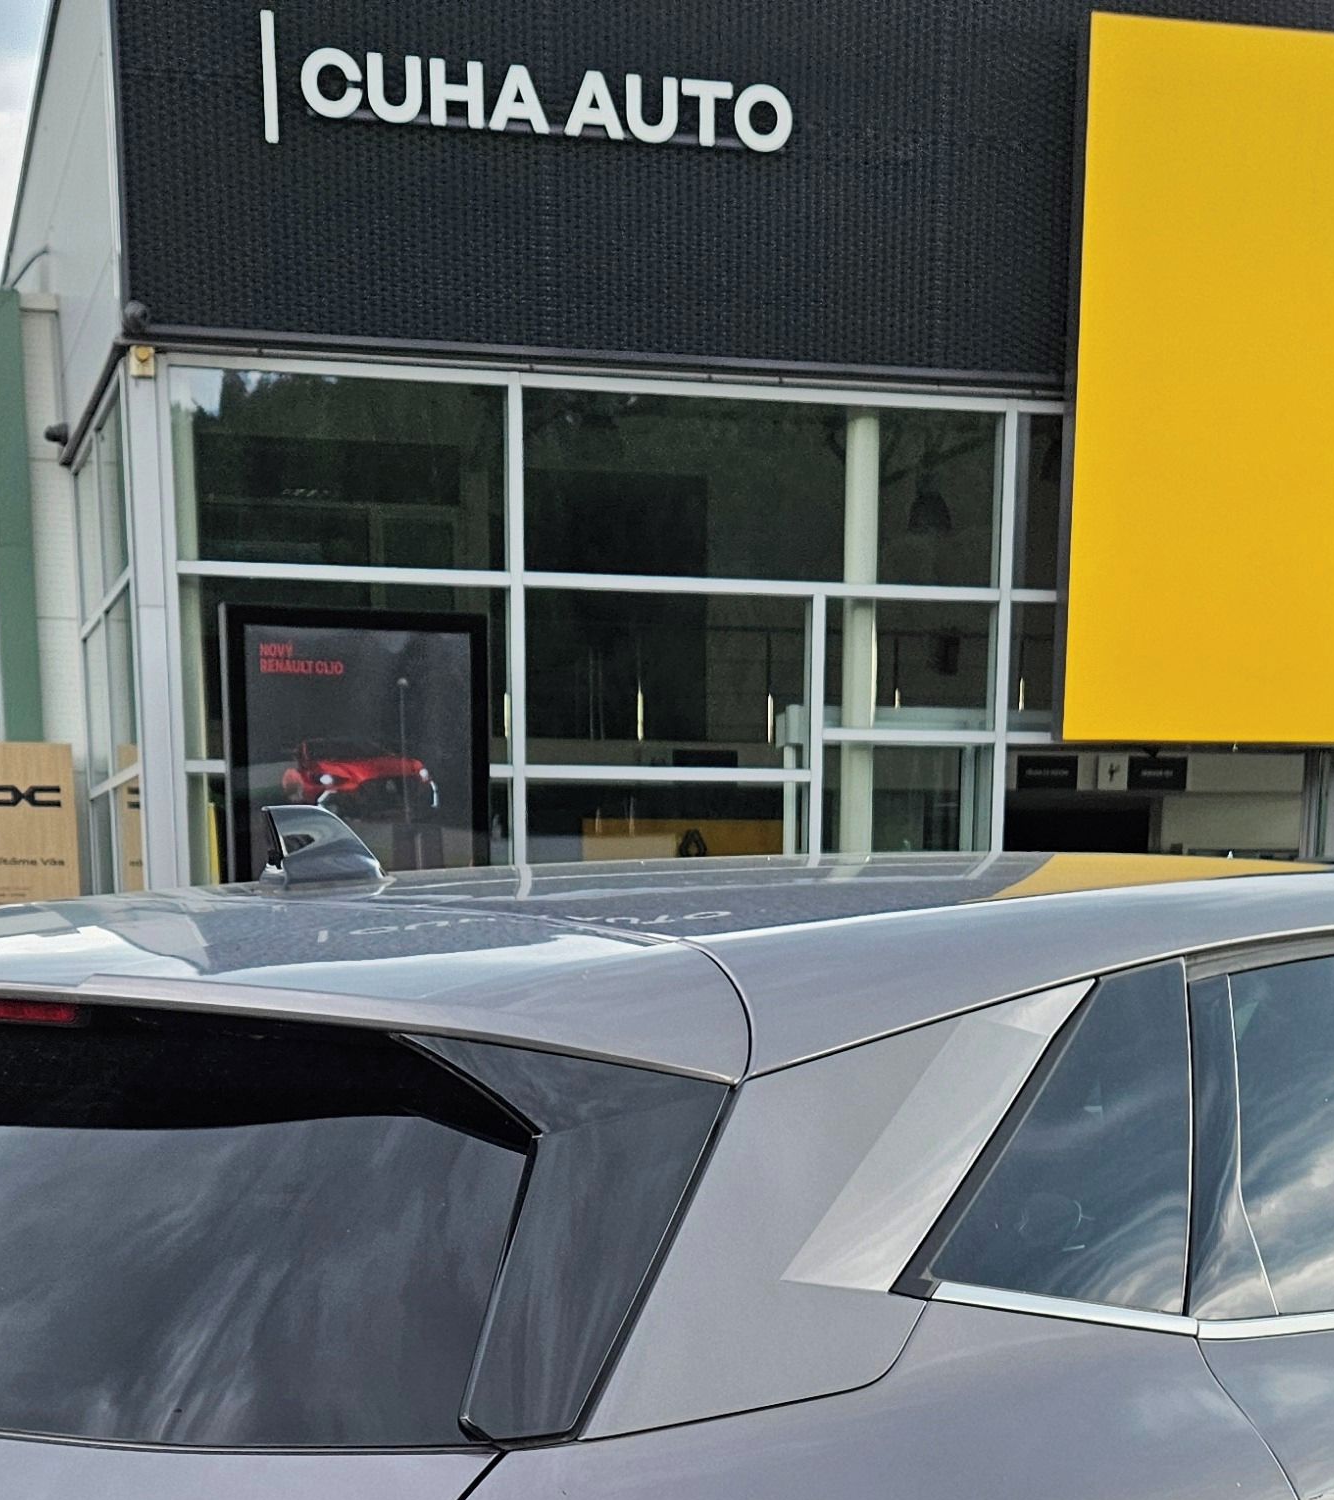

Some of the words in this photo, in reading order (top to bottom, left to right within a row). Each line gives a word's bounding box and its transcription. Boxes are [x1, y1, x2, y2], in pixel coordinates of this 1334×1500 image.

[300, 47, 551, 134] CUHA
[563, 70, 794, 152] AUTO
[259, 658, 314, 674] RENAULT
[314, 660, 344, 675] CLIO
